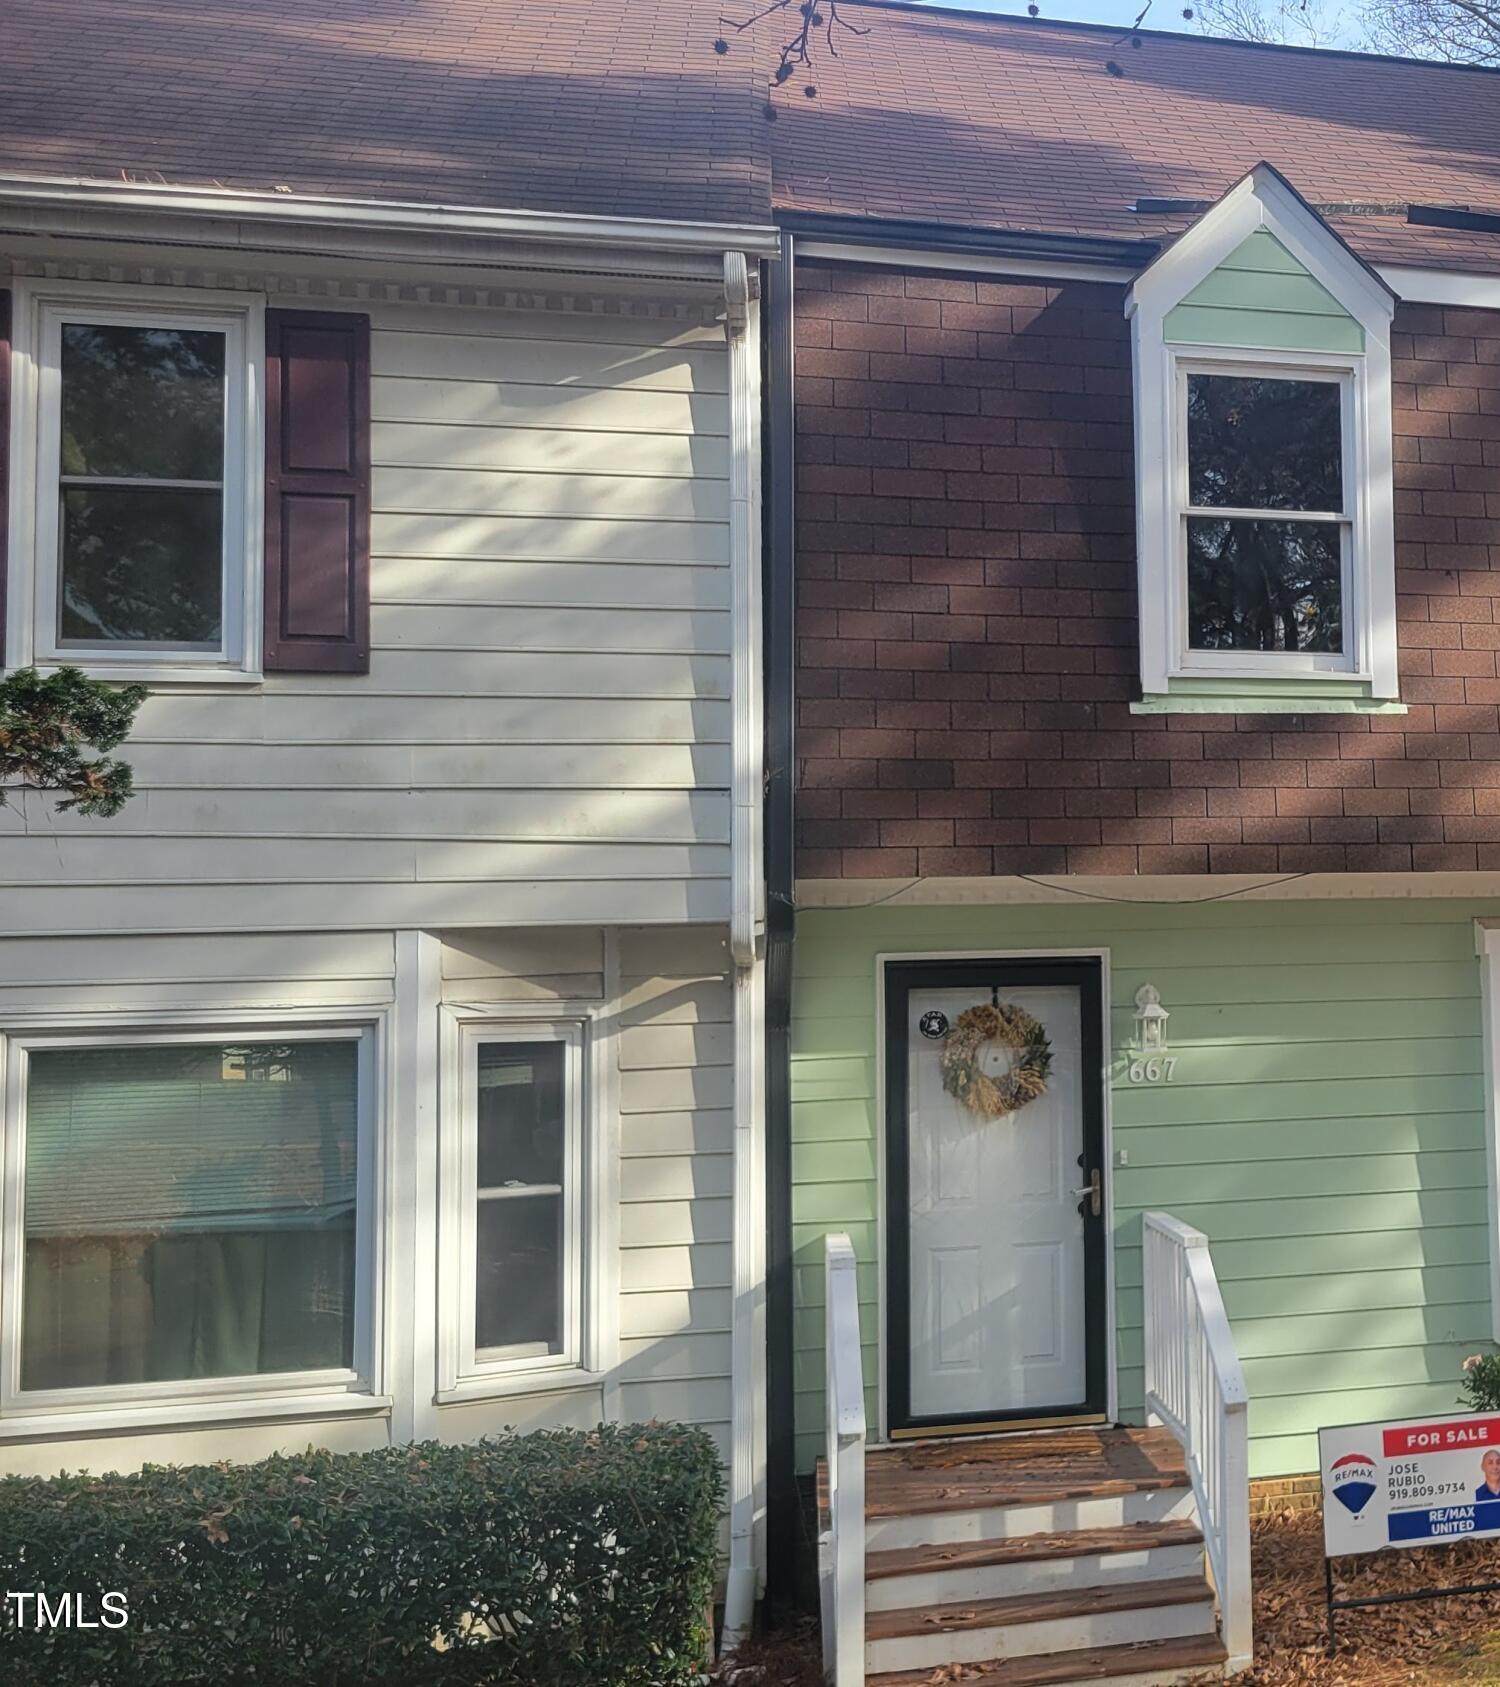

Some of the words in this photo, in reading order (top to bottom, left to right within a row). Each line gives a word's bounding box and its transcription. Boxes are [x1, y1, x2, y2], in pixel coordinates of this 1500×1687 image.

[1129, 1057, 1178, 1083] 667
[1407, 1434, 1440, 1447] FOR
[1447, 1427, 1488, 1442] SALE
[1335, 1469, 1373, 1482] RE/MAX
[1388, 1462, 1419, 1475] JOSE
[1388, 1475, 1425, 1488] RUBIO
[1389, 1482, 1466, 1500] 919.809.9734
[1429, 1506, 1475, 1523] RE/MAX
[1431, 1520, 1475, 1536] UNITED
